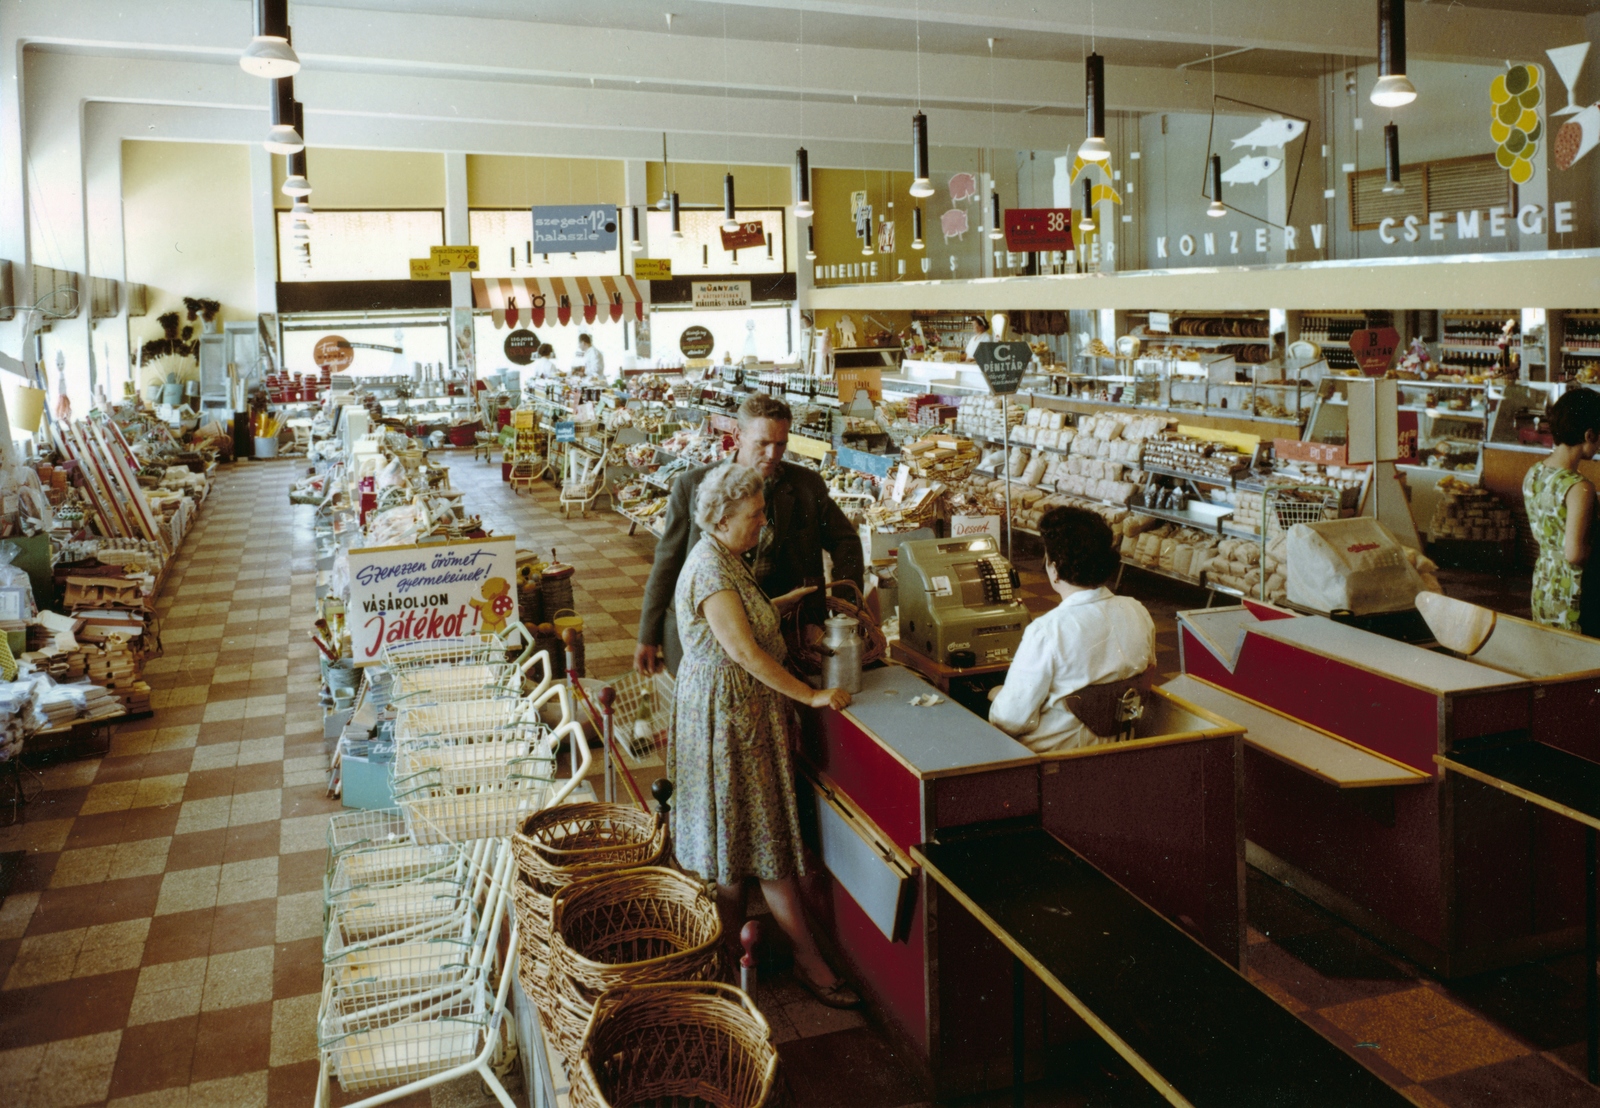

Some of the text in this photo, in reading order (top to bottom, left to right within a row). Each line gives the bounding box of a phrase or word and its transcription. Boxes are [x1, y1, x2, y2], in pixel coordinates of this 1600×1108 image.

[535, 215, 588, 228] szegedi
[1379, 202, 1578, 244] CSEMEGE
[1040, 234, 1116, 267] KENYÉR
[1157, 224, 1327, 259] KONZERV
[994, 250, 1029, 269] TEJ
[815, 261, 878, 279] MIRELITE
[700, 284, 740, 292] MŰANYAG
[508, 292, 621, 309] KÖNYV
[727, 298, 747, 306] VÁSÁR
[984, 357, 1023, 372] PÉNZTÁR
[953, 521, 990, 535] Dessert
[356, 549, 497, 586] Szerezzen örömet
[396, 563, 492, 593] gyermekeinek!
[363, 591, 449, 612] VÁSÁROLJON
